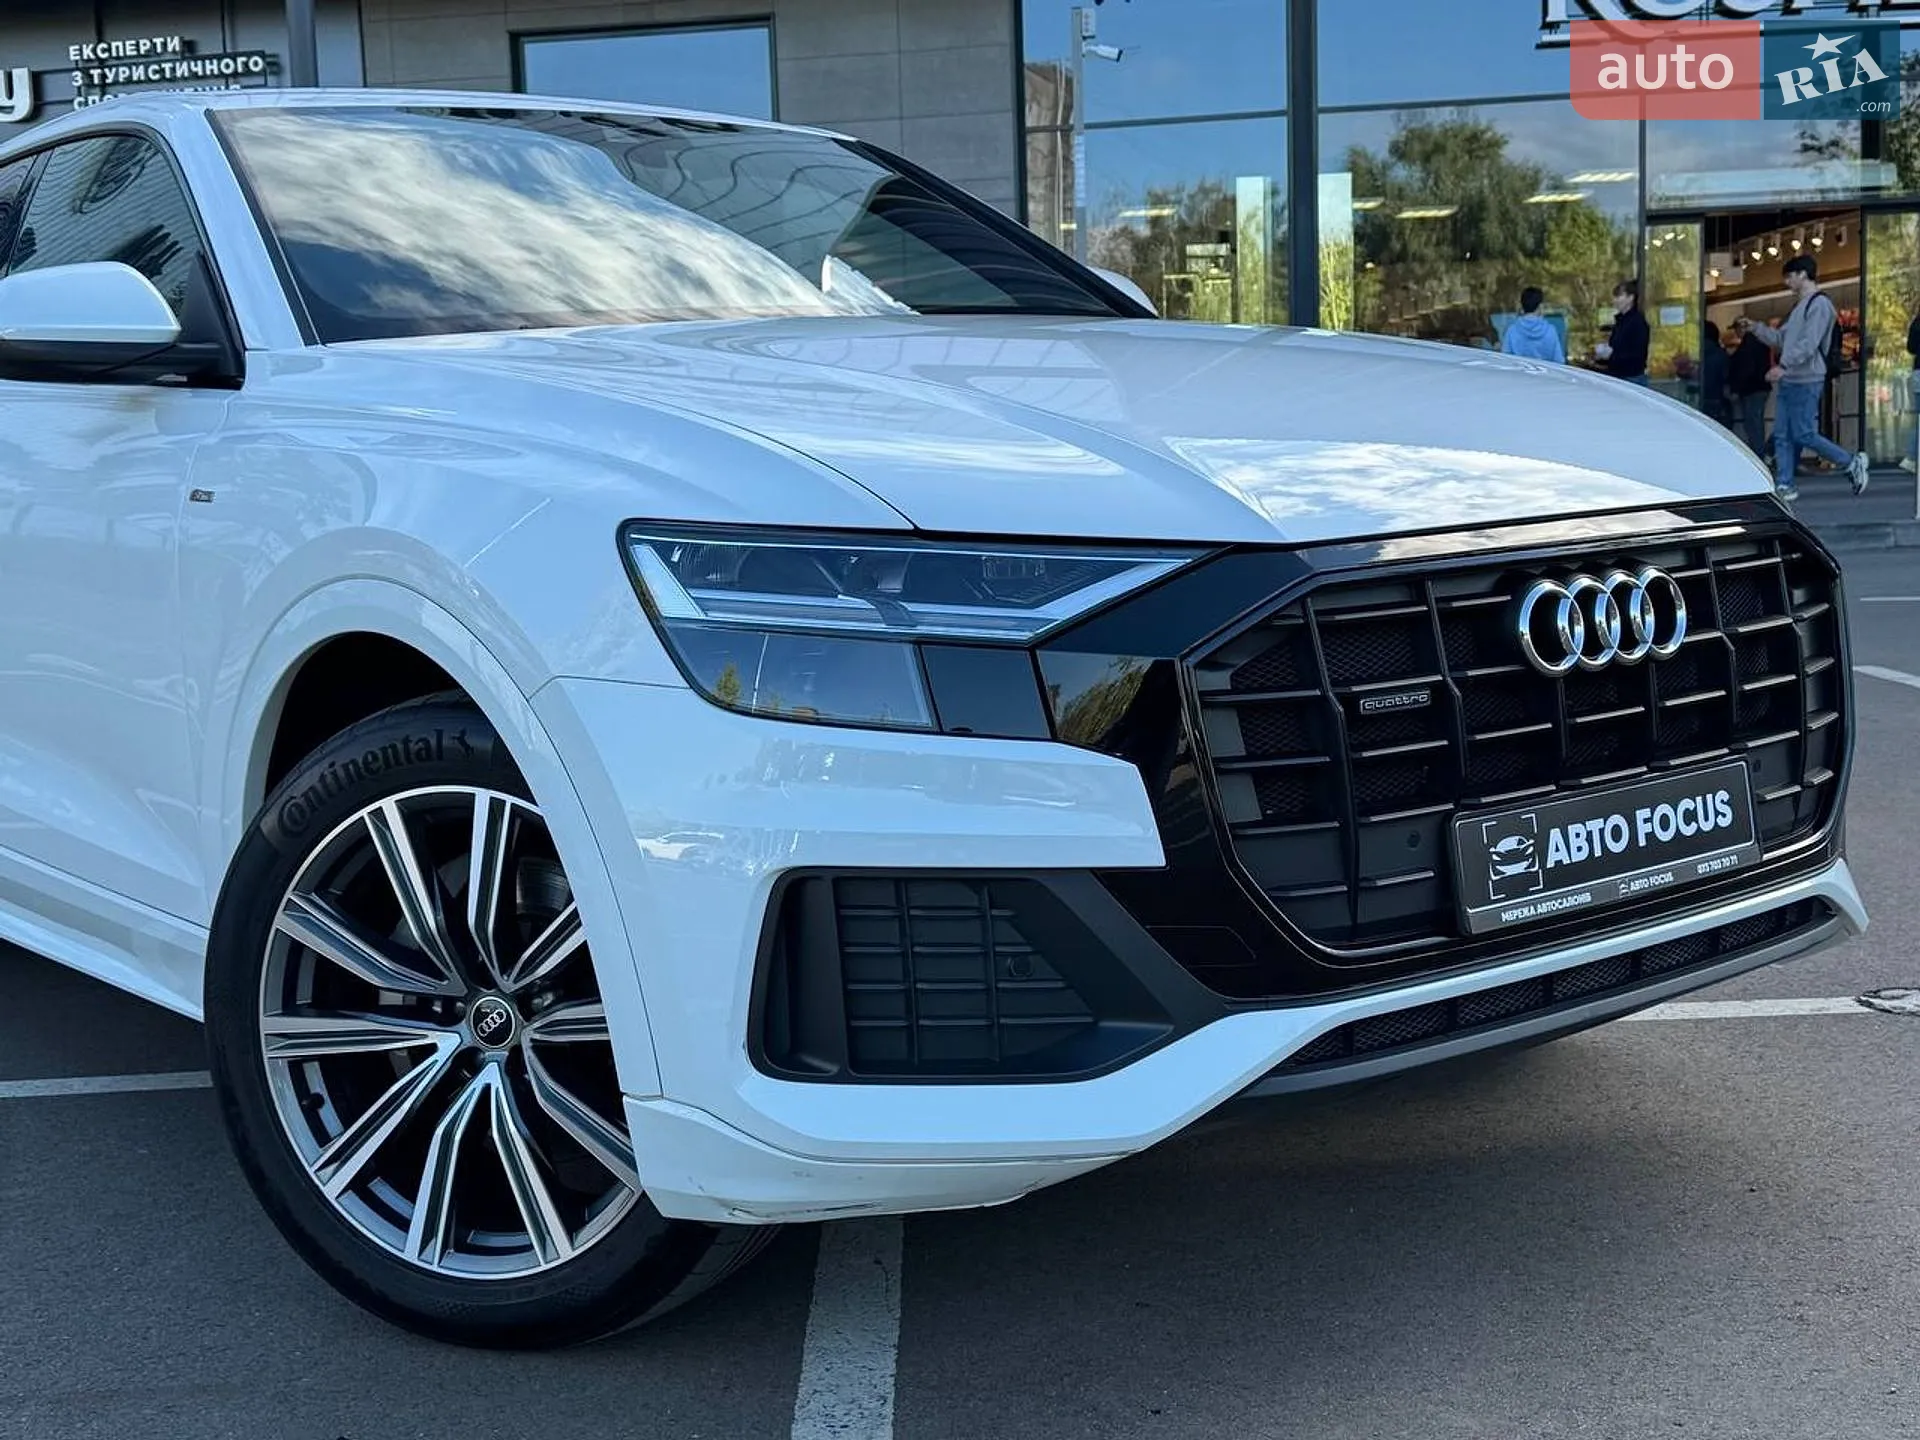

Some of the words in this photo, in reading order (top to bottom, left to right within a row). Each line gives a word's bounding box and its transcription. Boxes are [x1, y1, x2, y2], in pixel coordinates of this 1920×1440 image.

[68, 35, 182, 62] ЕКСПЕРТИ
[90, 55, 264, 85] ТУРИСТИЧНОГО
[1364, 694, 1428, 710] quattro
[278, 728, 444, 838] Continental
[1546, 814, 1630, 869] АВТО
[1635, 790, 1734, 847] FOCUS
